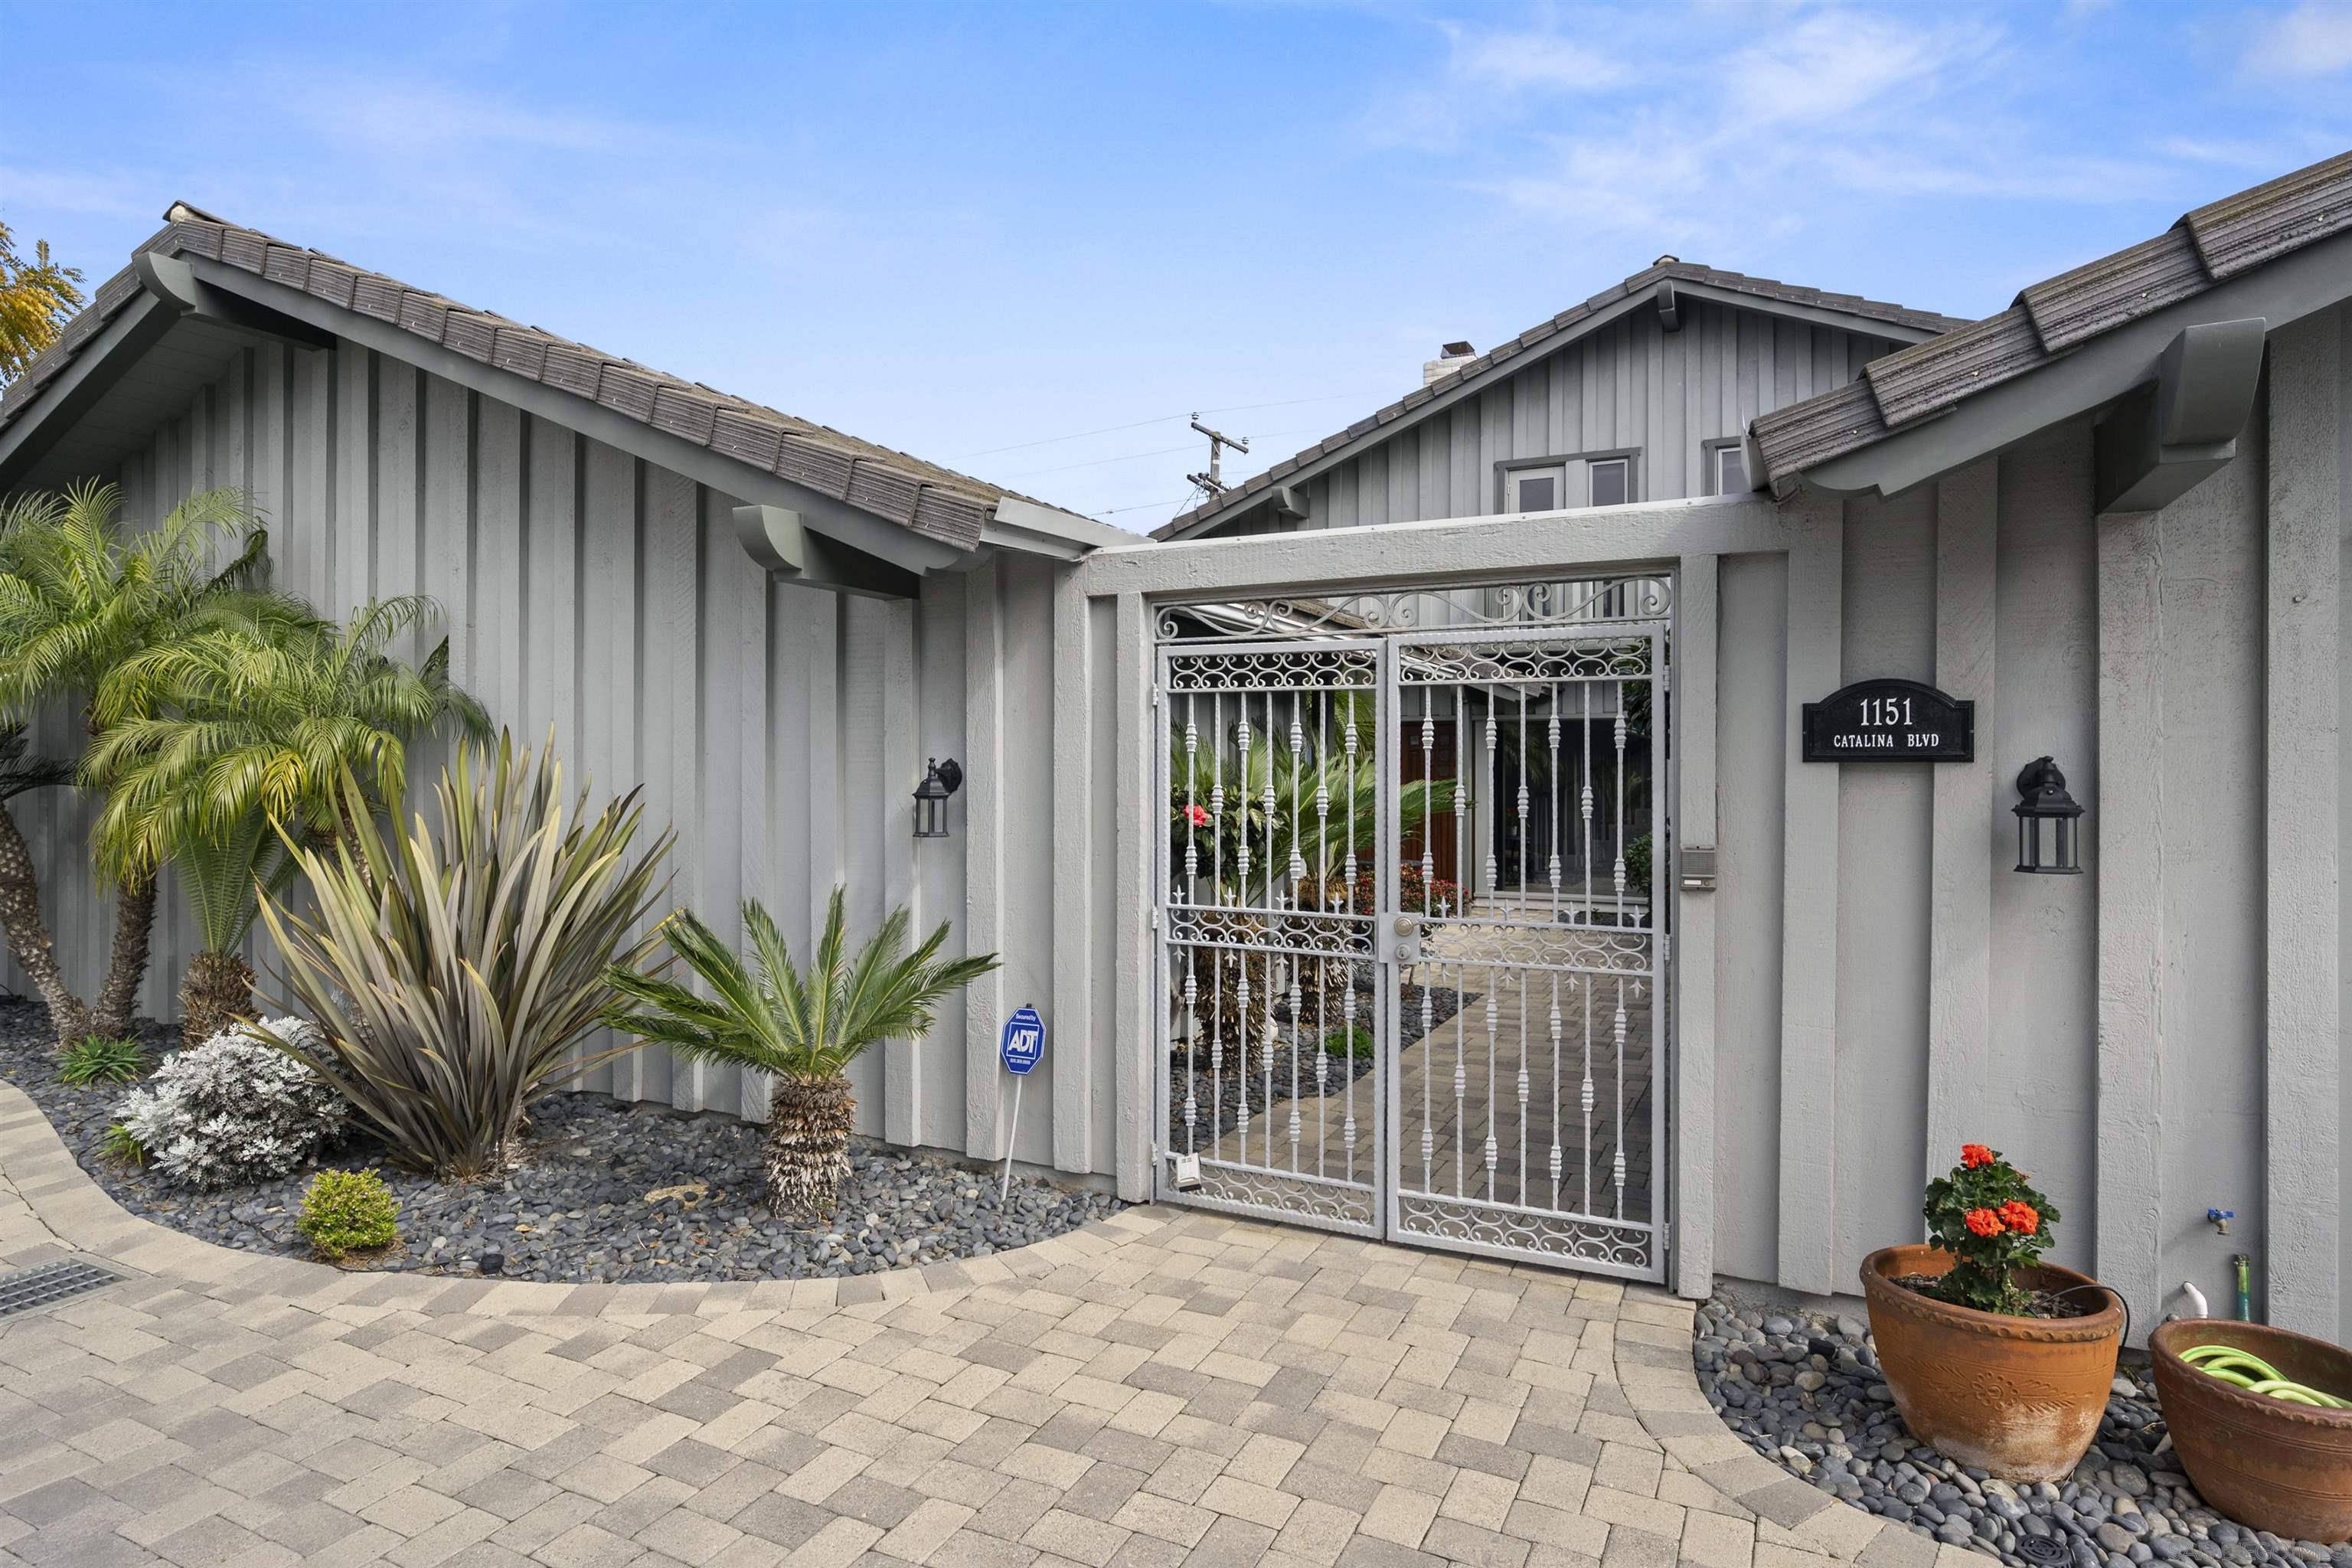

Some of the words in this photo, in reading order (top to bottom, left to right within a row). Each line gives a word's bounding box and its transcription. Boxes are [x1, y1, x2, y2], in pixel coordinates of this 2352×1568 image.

[1860, 697, 1913, 726] 1151
[1834, 733, 1893, 748] CATALINA
[1907, 733, 1939, 747] BLVD
[1008, 1029, 1038, 1054] ADT
